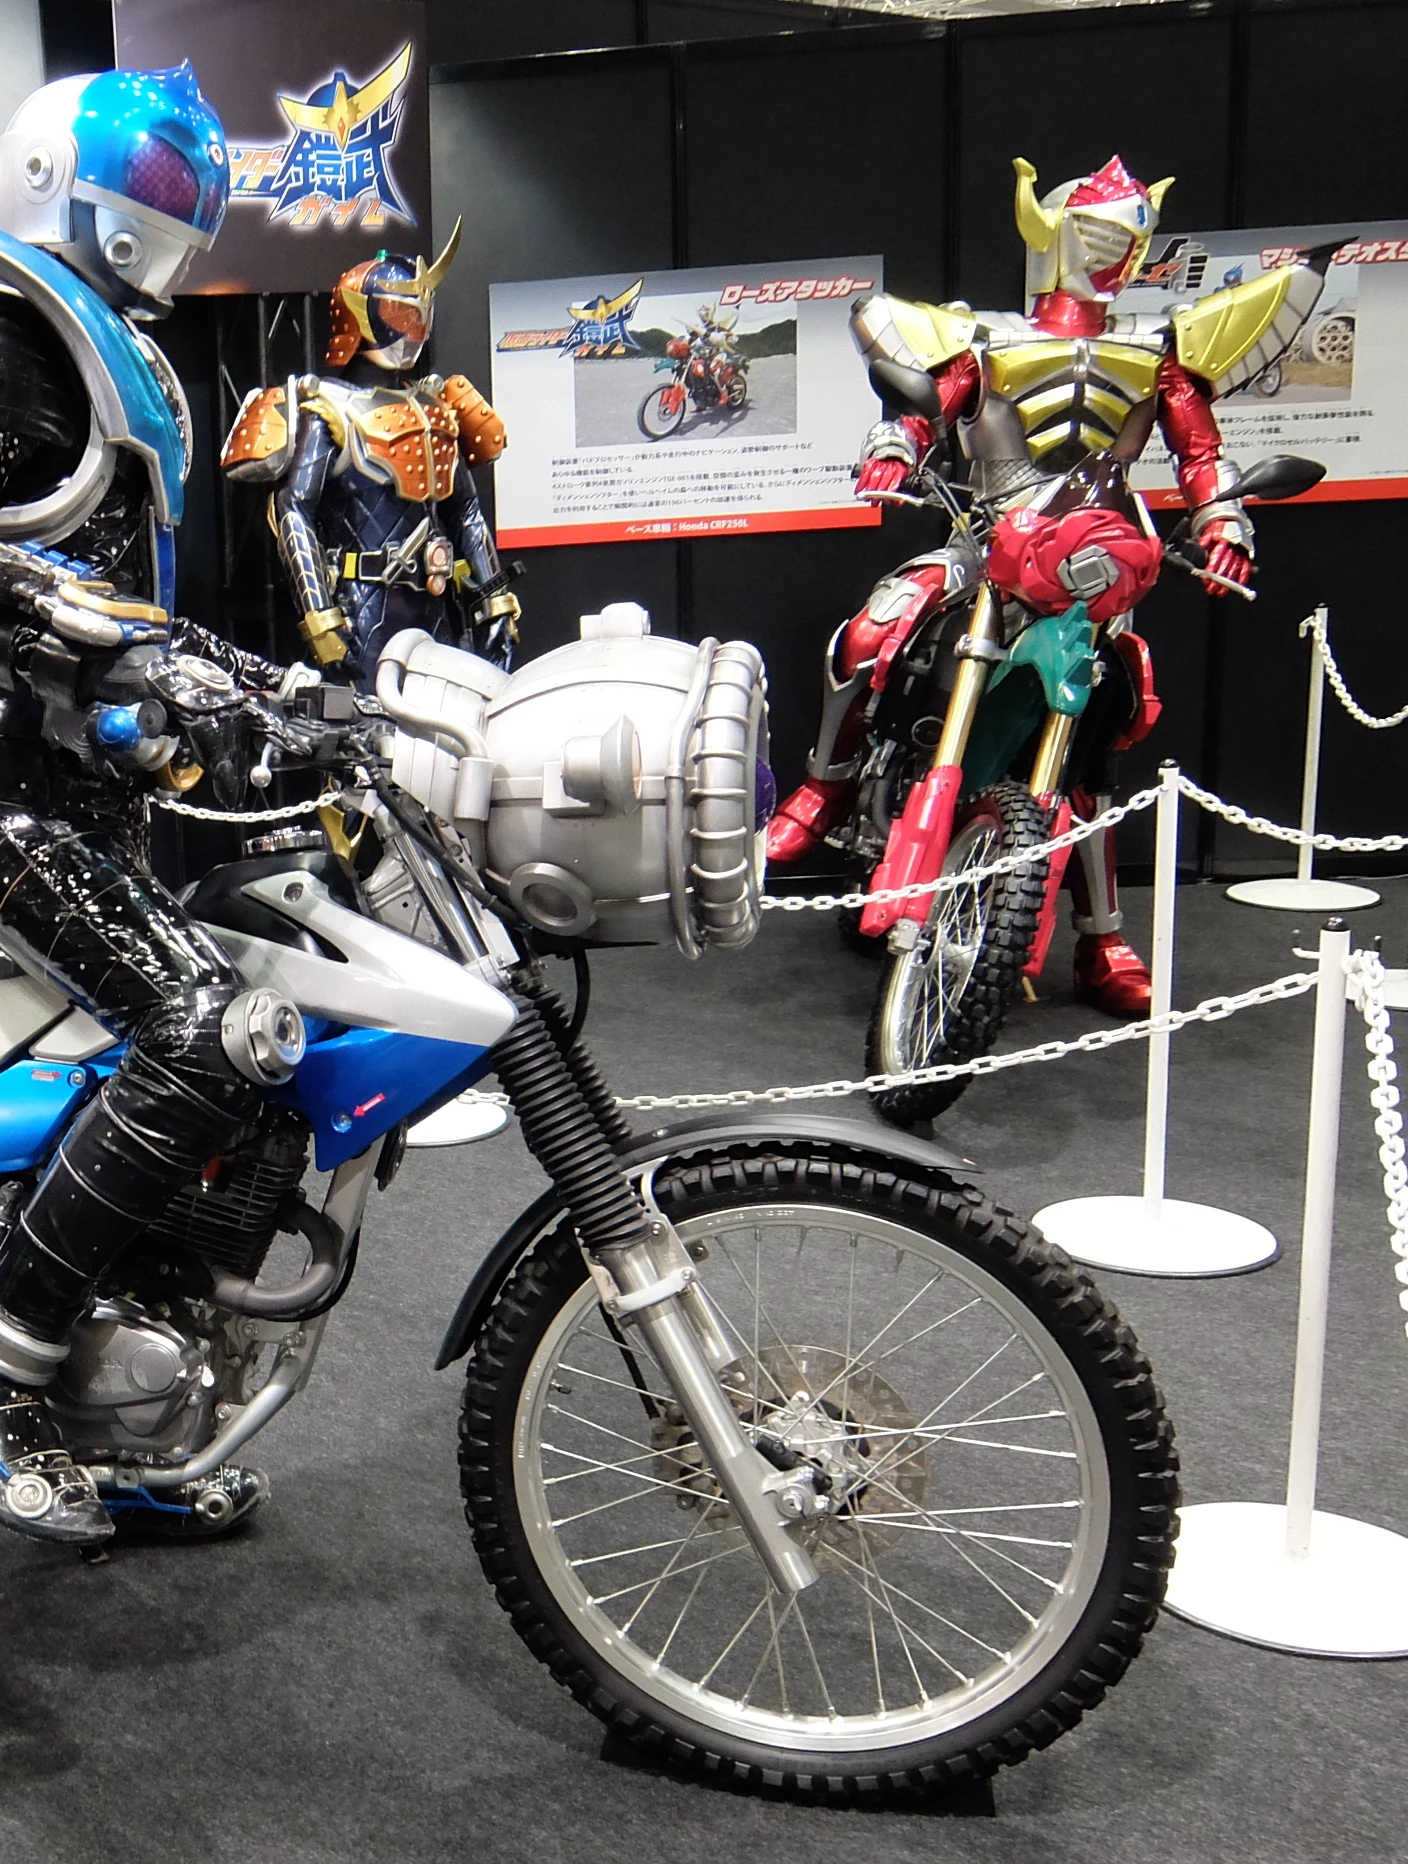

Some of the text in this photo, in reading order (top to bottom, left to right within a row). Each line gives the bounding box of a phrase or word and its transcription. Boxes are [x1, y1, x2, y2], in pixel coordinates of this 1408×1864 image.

[228, 149, 285, 190] イダー
[289, 196, 385, 226] ガイム
[720, 276, 874, 305] ローズアタッカー
[573, 340, 626, 357] ガイム
[678, 521, 709, 531] Honda
[710, 519, 750, 529] CRF250L
